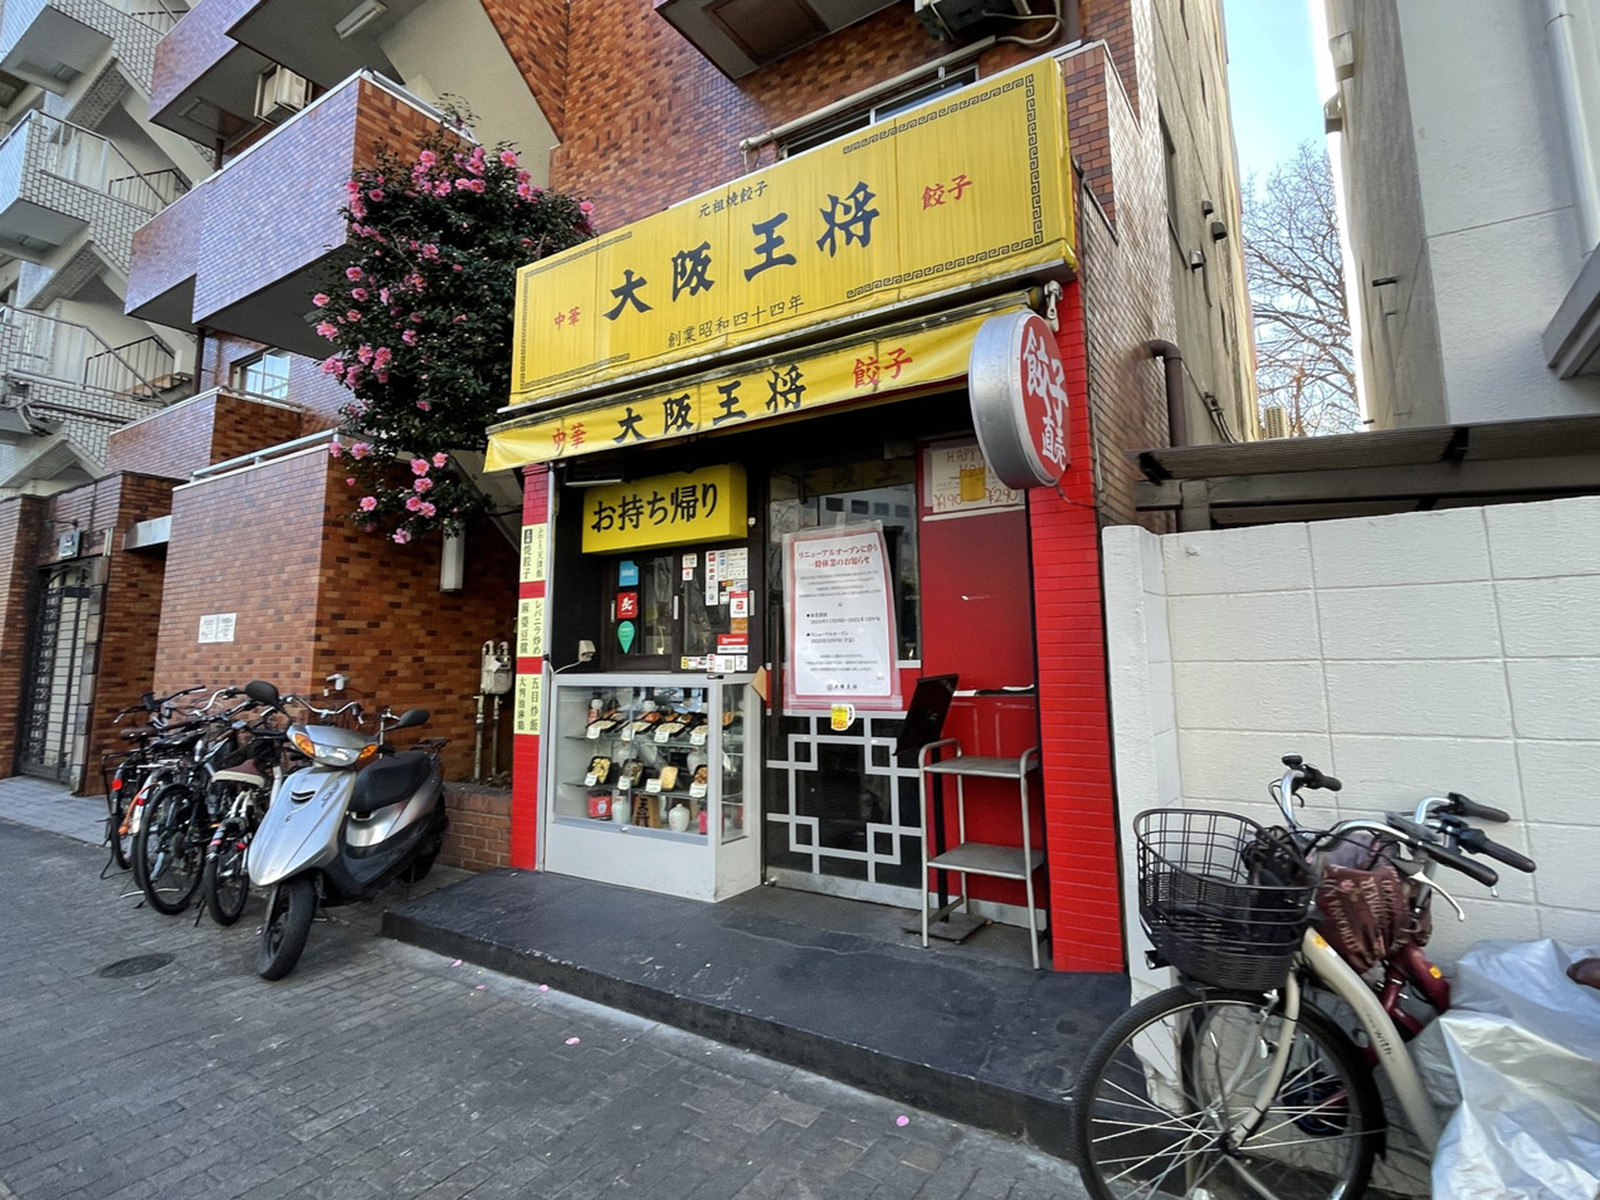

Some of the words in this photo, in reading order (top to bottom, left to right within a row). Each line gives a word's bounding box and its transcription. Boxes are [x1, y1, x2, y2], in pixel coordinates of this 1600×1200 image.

[921, 174, 973, 211] 餃子
[603, 181, 880, 321] 大阪王将
[554, 306, 581, 331] 中華
[668, 294, 804, 348] 創業昭和四十四年
[853, 347, 913, 389] 餃子
[1023, 326, 1069, 427] 餃子
[612, 363, 807, 445] 大阪王将
[552, 422, 587, 452] 中華
[946, 447, 984, 462] HAPP
[591, 483, 718, 534] お持ち帰り
